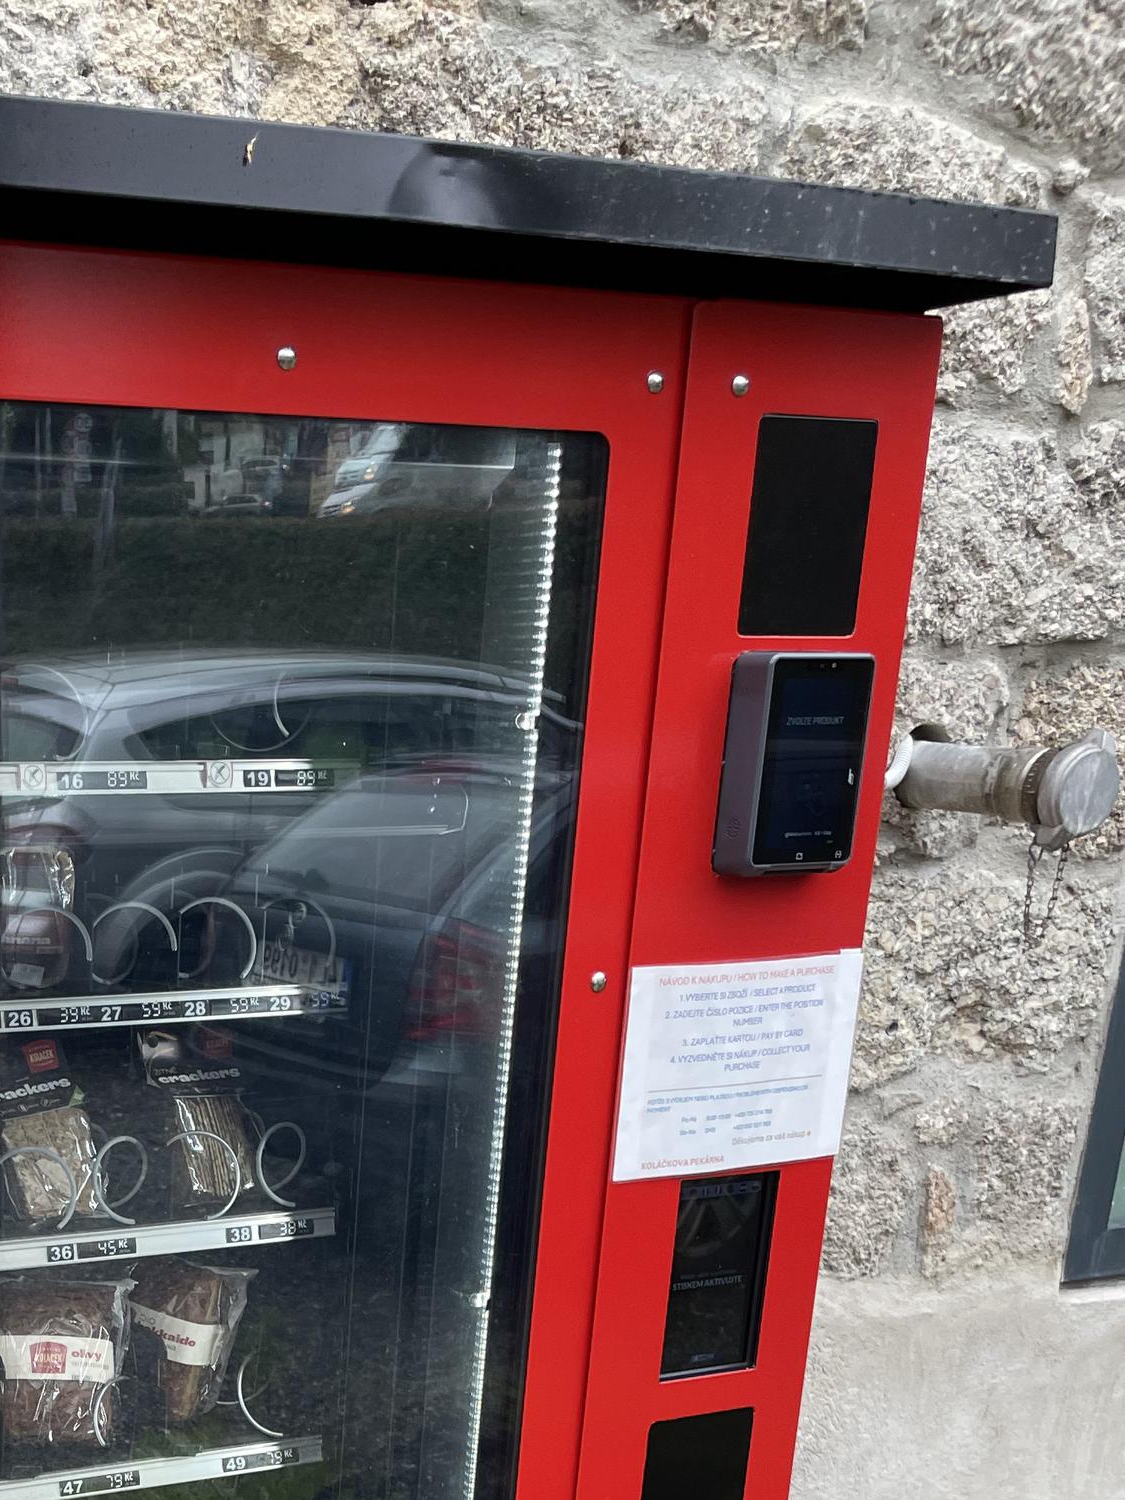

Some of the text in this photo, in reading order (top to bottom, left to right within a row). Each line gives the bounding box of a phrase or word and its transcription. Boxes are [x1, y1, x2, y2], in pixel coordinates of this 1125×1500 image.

[60, 770, 127, 790] 16 89
[247, 770, 315, 788] 19 89
[659, 975, 690, 987] NÁVOD
[698, 973, 733, 985] NÁKUPU
[737, 973, 756, 982] HOW
[758, 971, 769, 980] TO
[796, 965, 835, 976] PURCHASE
[754, 986, 778, 997] SELECT
[784, 983, 816, 994] PRODUCT
[8, 1011, 31, 1027] 26
[60, 1007, 78, 1023] 39
[101, 1006, 123, 1022] 27
[142, 1001, 160, 1018] 59
[184, 1001, 206, 1017] 28
[230, 998, 249, 1013] 59
[269, 996, 291, 1012] 29
[673, 998, 824, 1019] ZADEJTE ČÍSLO POZICE ENTER THE POSITION
[733, 1016, 763, 1027] NUMBER
[727, 1033, 756, 1044] KARTOU
[761, 1031, 774, 1040] PAY
[784, 1028, 803, 1038] CARD
[734, 1049, 757, 1060] NÁKUP
[761, 1046, 791, 1056] COLLECT
[791, 1044, 811, 1053] YOUR
[724, 1061, 761, 1072] PURCHASE
[158, 1067, 241, 1084] crackers
[640, 1154, 724, 1171] KOLÁČKOVA PEKÁRNA
[230, 1227, 251, 1242] 38
[50, 1240, 117, 1261] 36 45
[225, 1456, 246, 1471] 49
[62, 1473, 123, 1495] 47 79
